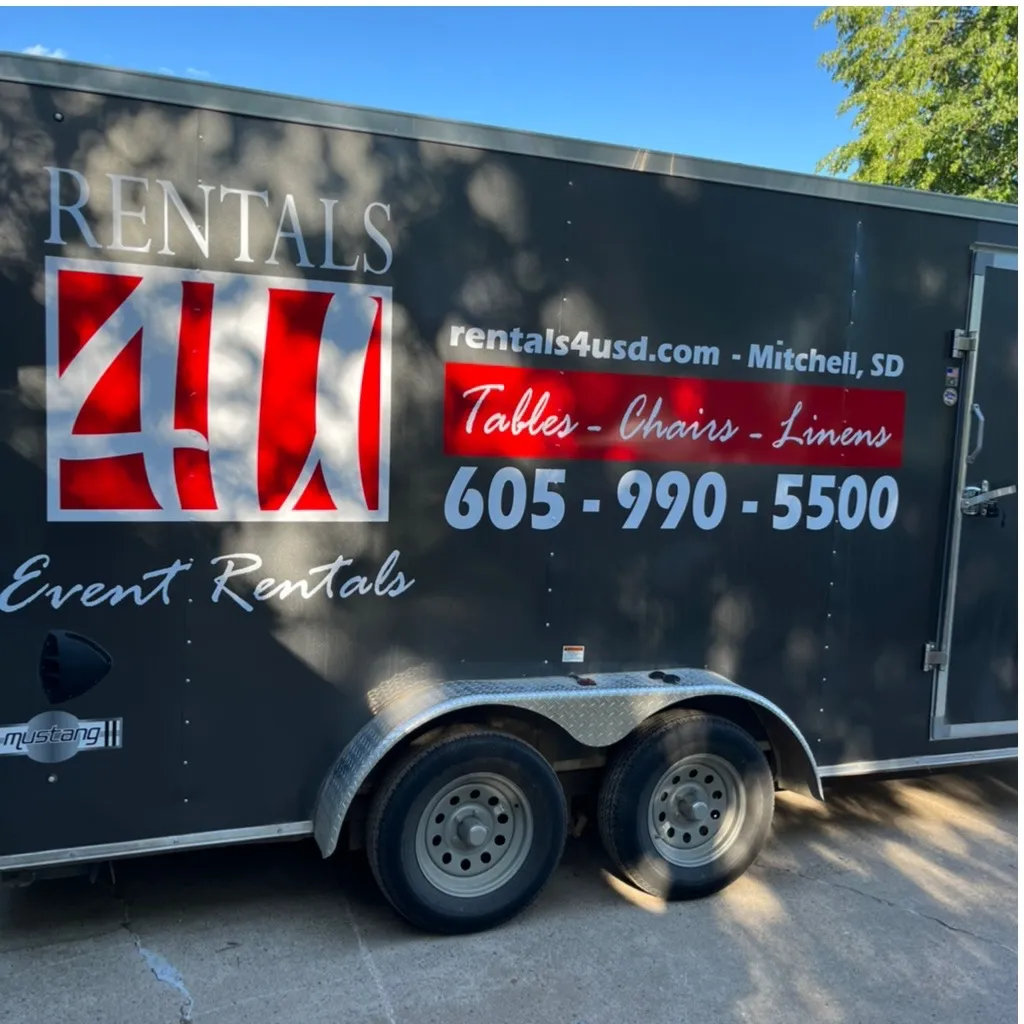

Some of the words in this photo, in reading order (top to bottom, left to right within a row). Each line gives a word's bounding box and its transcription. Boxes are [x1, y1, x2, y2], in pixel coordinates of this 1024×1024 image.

[43, 166, 394, 275] RENTALS
[449, 325, 719, 365] rentals4usd.com
[748, 340, 863, 380] Mitchell,
[871, 353, 904, 378] SD
[463, 383, 579, 439] Tables
[587, 424, 601, 433] -
[619, 394, 739, 443] Chairs
[749, 432, 763, 440] -
[772, 401, 892, 448] Linens
[444, 466, 567, 530] 605
[582, 499, 599, 512] -
[617, 470, 727, 530] 990
[742, 501, 757, 512] -
[772, 474, 898, 530] 5500
[0, 554, 192, 613] Event
[211, 550, 415, 612] Rentals
[3, 724, 101, 750] mustang
